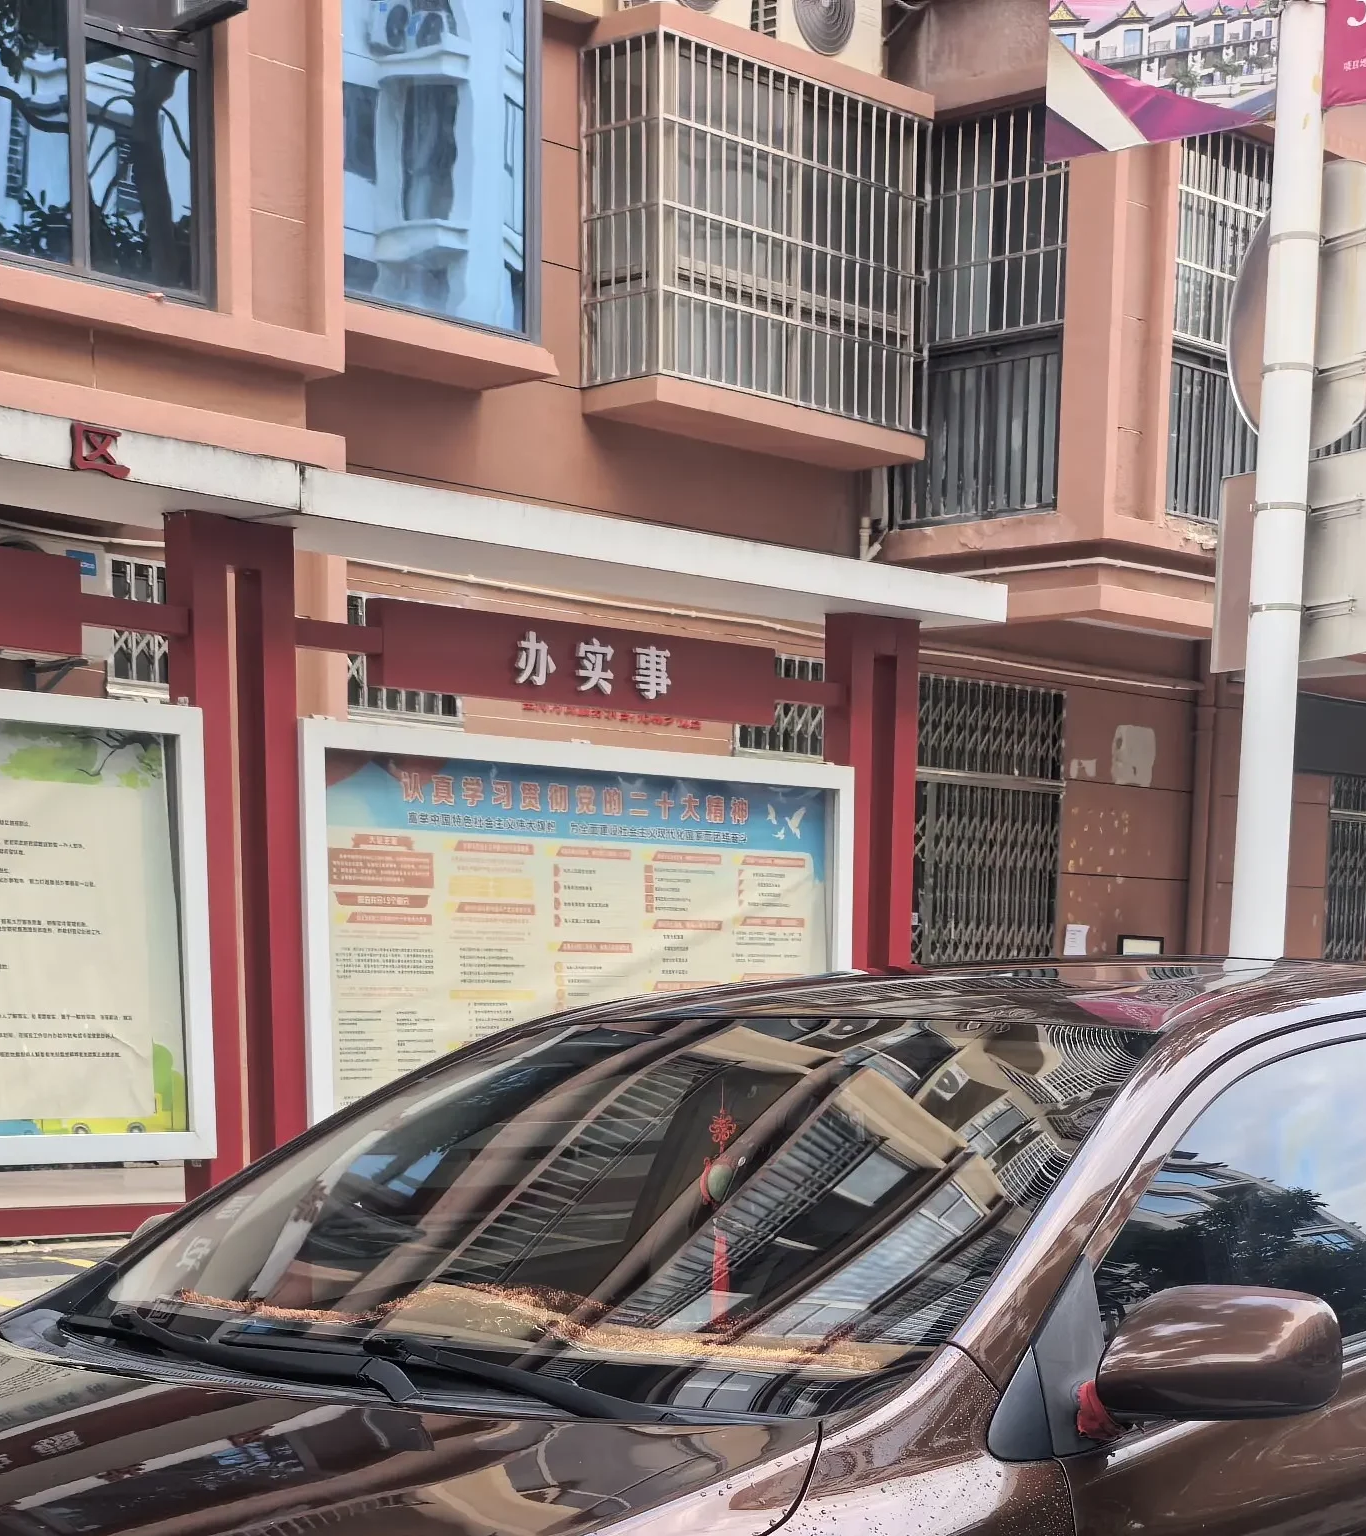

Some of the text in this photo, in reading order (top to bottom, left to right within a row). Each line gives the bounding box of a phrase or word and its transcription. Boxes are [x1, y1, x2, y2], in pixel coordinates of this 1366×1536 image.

[514, 630, 672, 699] 办实事
[399, 770, 751, 825] 认真学习贯彻党的二十大精神
